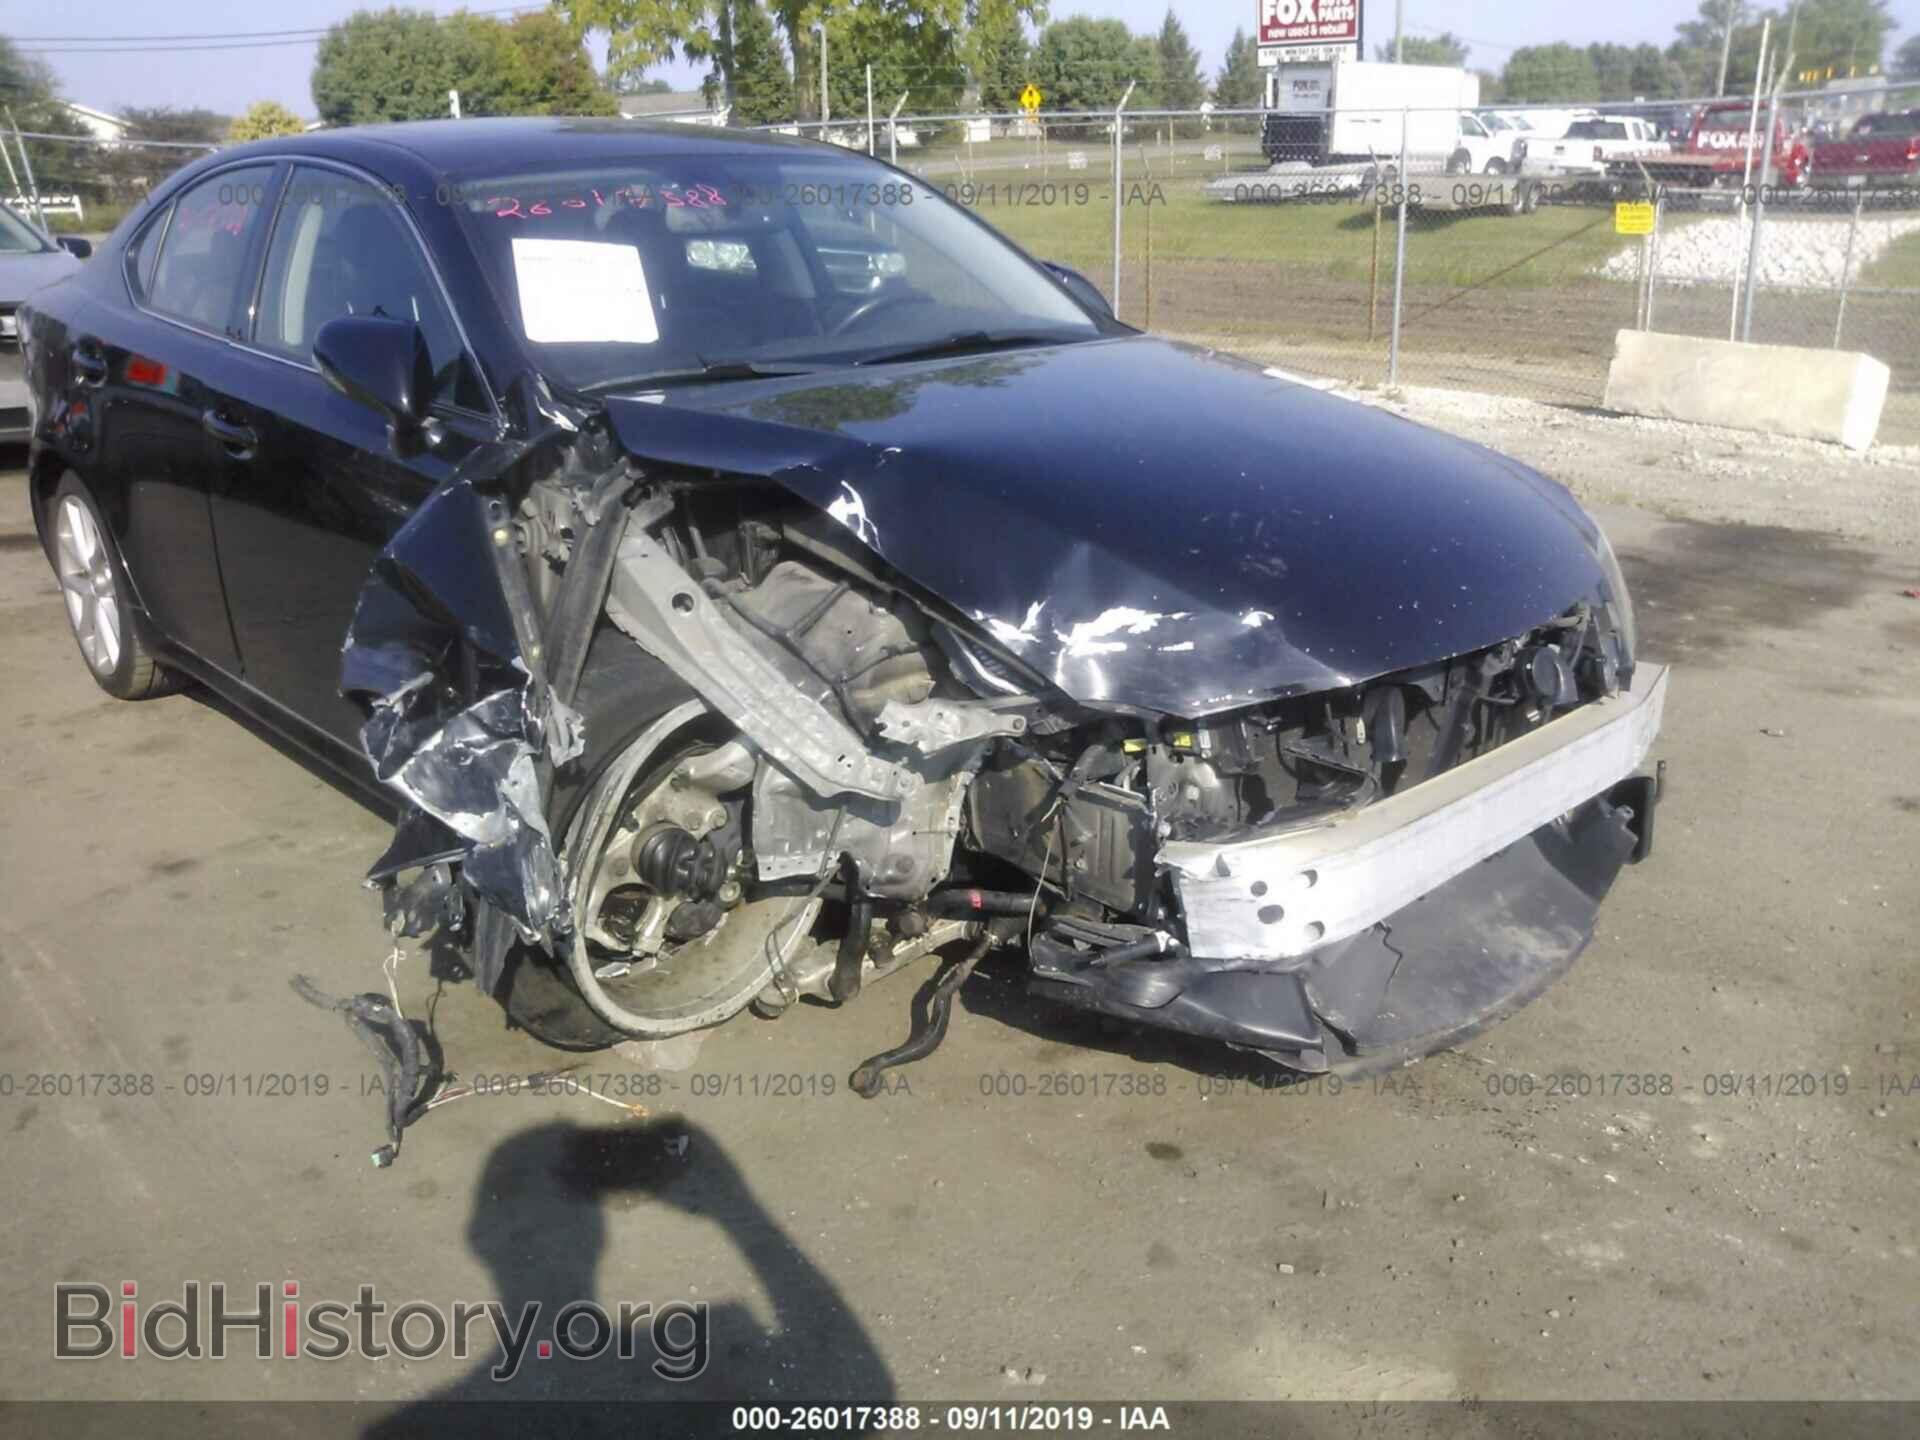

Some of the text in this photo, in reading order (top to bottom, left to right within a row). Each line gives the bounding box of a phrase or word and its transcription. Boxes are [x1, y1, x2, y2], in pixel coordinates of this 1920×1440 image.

[1262, 0, 1317, 26] FOX
[1318, 6, 1354, 21] PARTS
[1267, 28, 1286, 39] new
[1287, 24, 1310, 37] used
[1697, 130, 1737, 149] FOX
